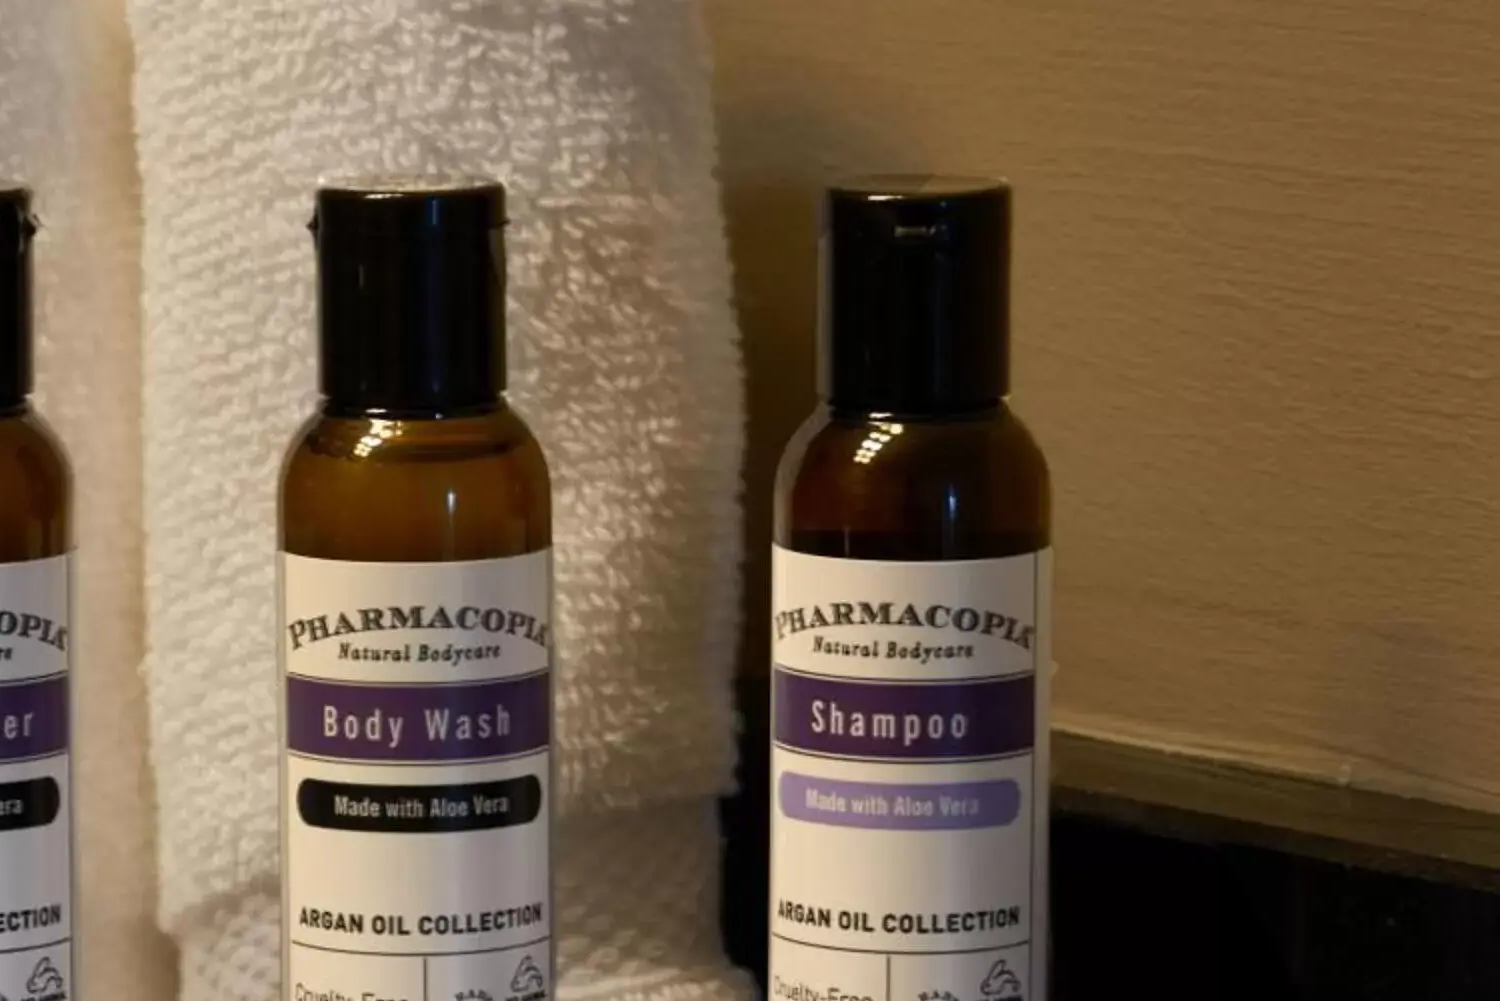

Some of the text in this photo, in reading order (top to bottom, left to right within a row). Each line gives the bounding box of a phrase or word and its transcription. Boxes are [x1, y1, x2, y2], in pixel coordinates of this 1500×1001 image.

[338, 643, 500, 666] Natural Bodycare
[812, 636, 975, 664] Natural Bodycare
[323, 704, 510, 748] Body Wash
[812, 700, 968, 746] Shampoo
[334, 795, 510, 818] Made with Aloe Vera
[806, 787, 979, 816] Made with Aloe Vera
[300, 902, 543, 935] ARGAN OIL COLLECTION
[778, 899, 1020, 934] ARGAN OIL COLLECTION
